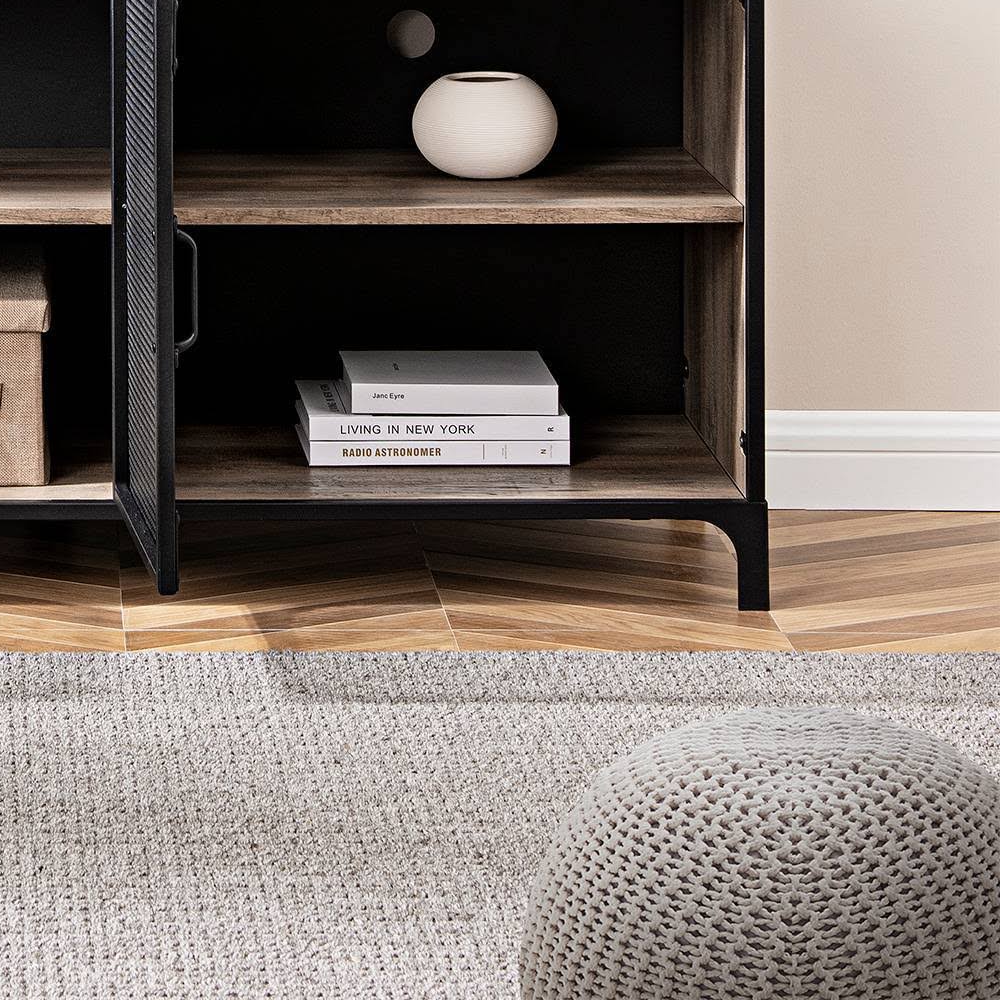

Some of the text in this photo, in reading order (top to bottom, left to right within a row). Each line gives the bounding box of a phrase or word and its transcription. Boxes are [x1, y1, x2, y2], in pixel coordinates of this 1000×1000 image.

[340, 425, 475, 435] LIVING IN NEW YORK
[342, 448, 441, 457] RADIO ASTRONOMER
